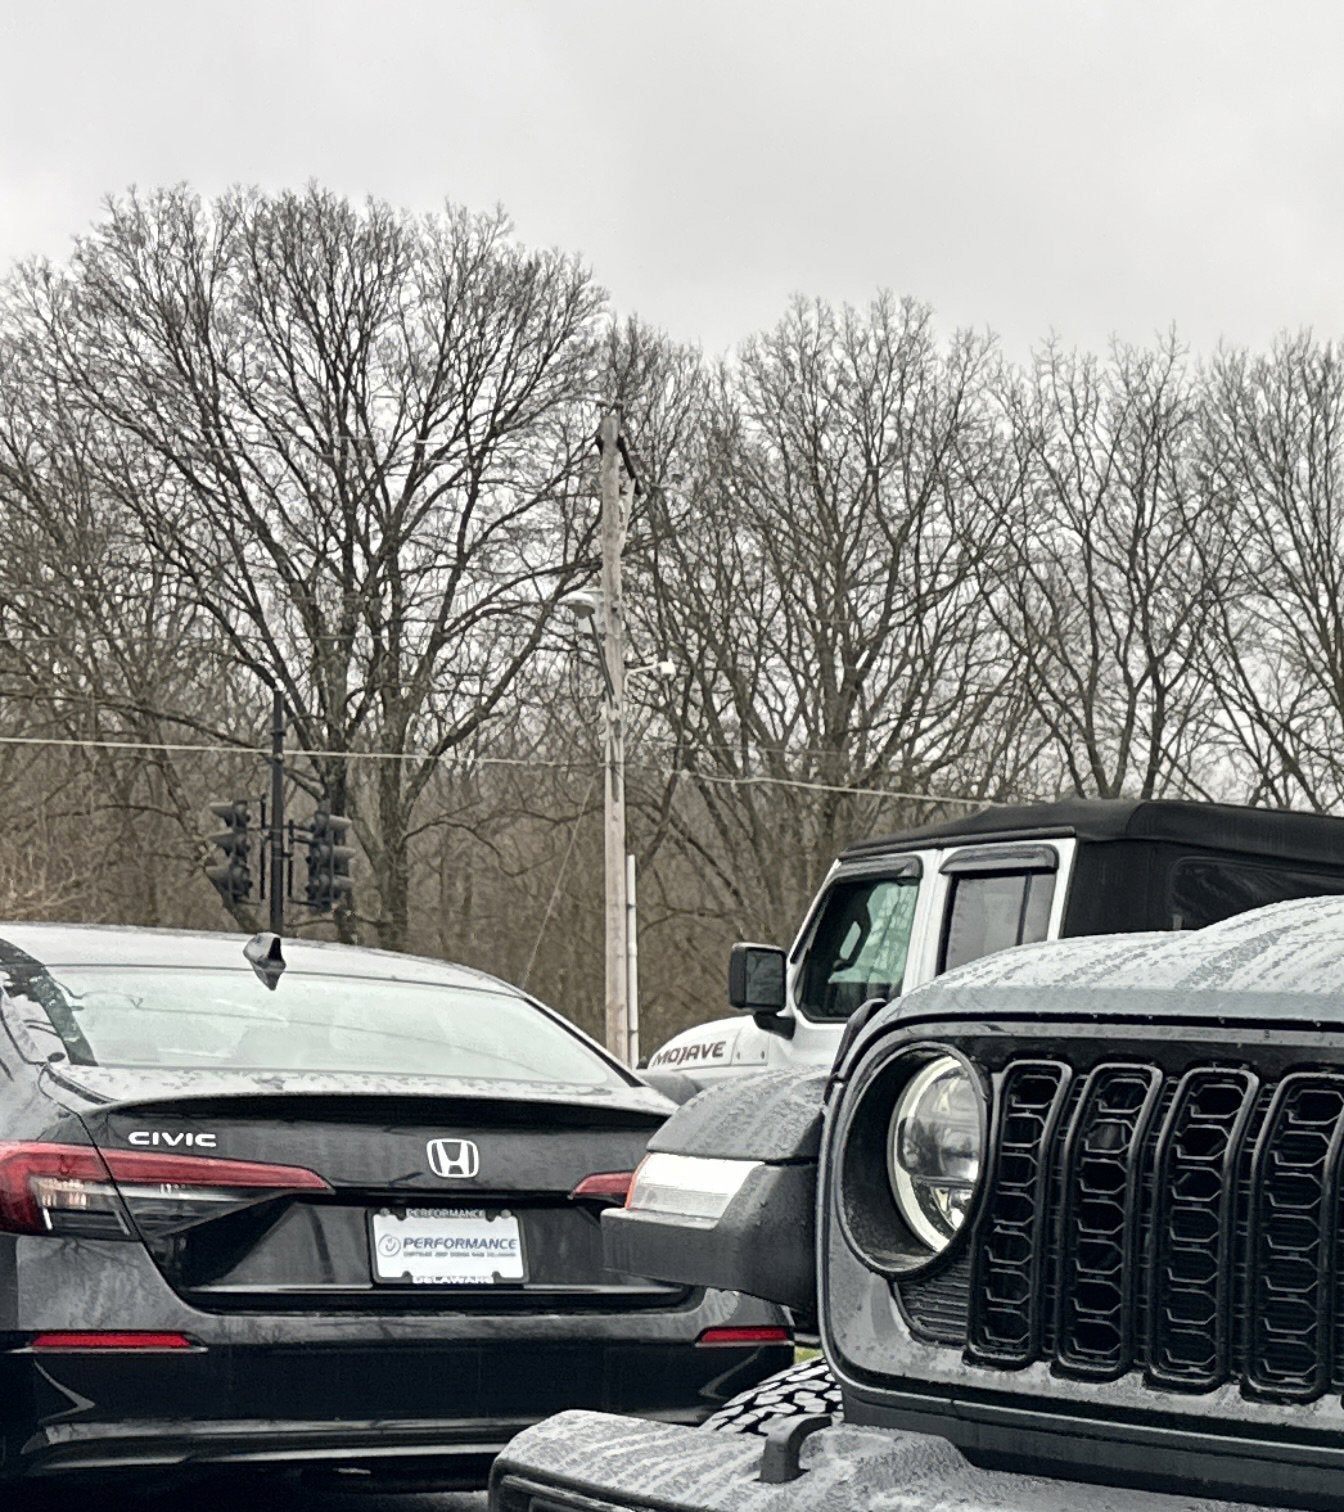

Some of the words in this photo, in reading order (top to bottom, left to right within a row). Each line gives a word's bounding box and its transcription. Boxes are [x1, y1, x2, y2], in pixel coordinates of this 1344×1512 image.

[651, 1041, 727, 1067] MOJAVE
[128, 1131, 217, 1148] CIVIC
[405, 1207, 487, 1219] PERFORMANCE
[403, 1236, 518, 1250] PERFORMANCE
